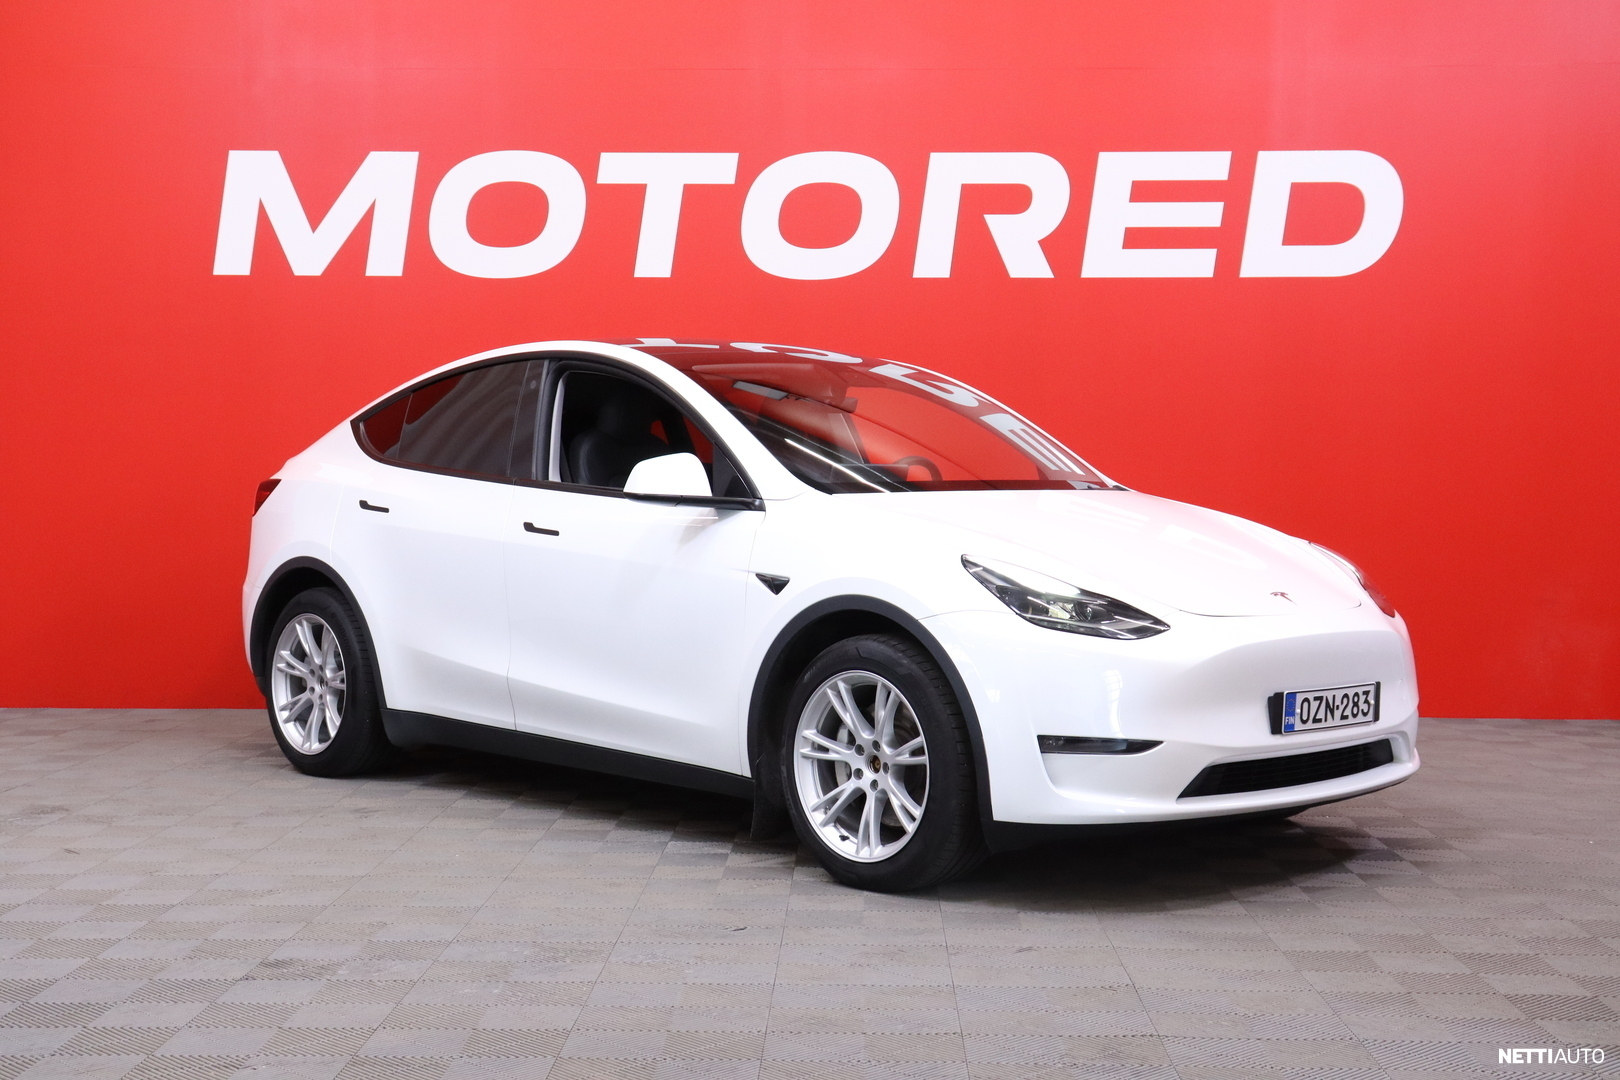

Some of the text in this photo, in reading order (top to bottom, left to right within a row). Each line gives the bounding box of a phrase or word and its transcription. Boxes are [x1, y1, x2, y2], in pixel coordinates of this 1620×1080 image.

[213, 149, 1404, 280] MOTORED
[1284, 716, 1295, 725] FIN
[1300, 690, 1371, 724] OZN-283
